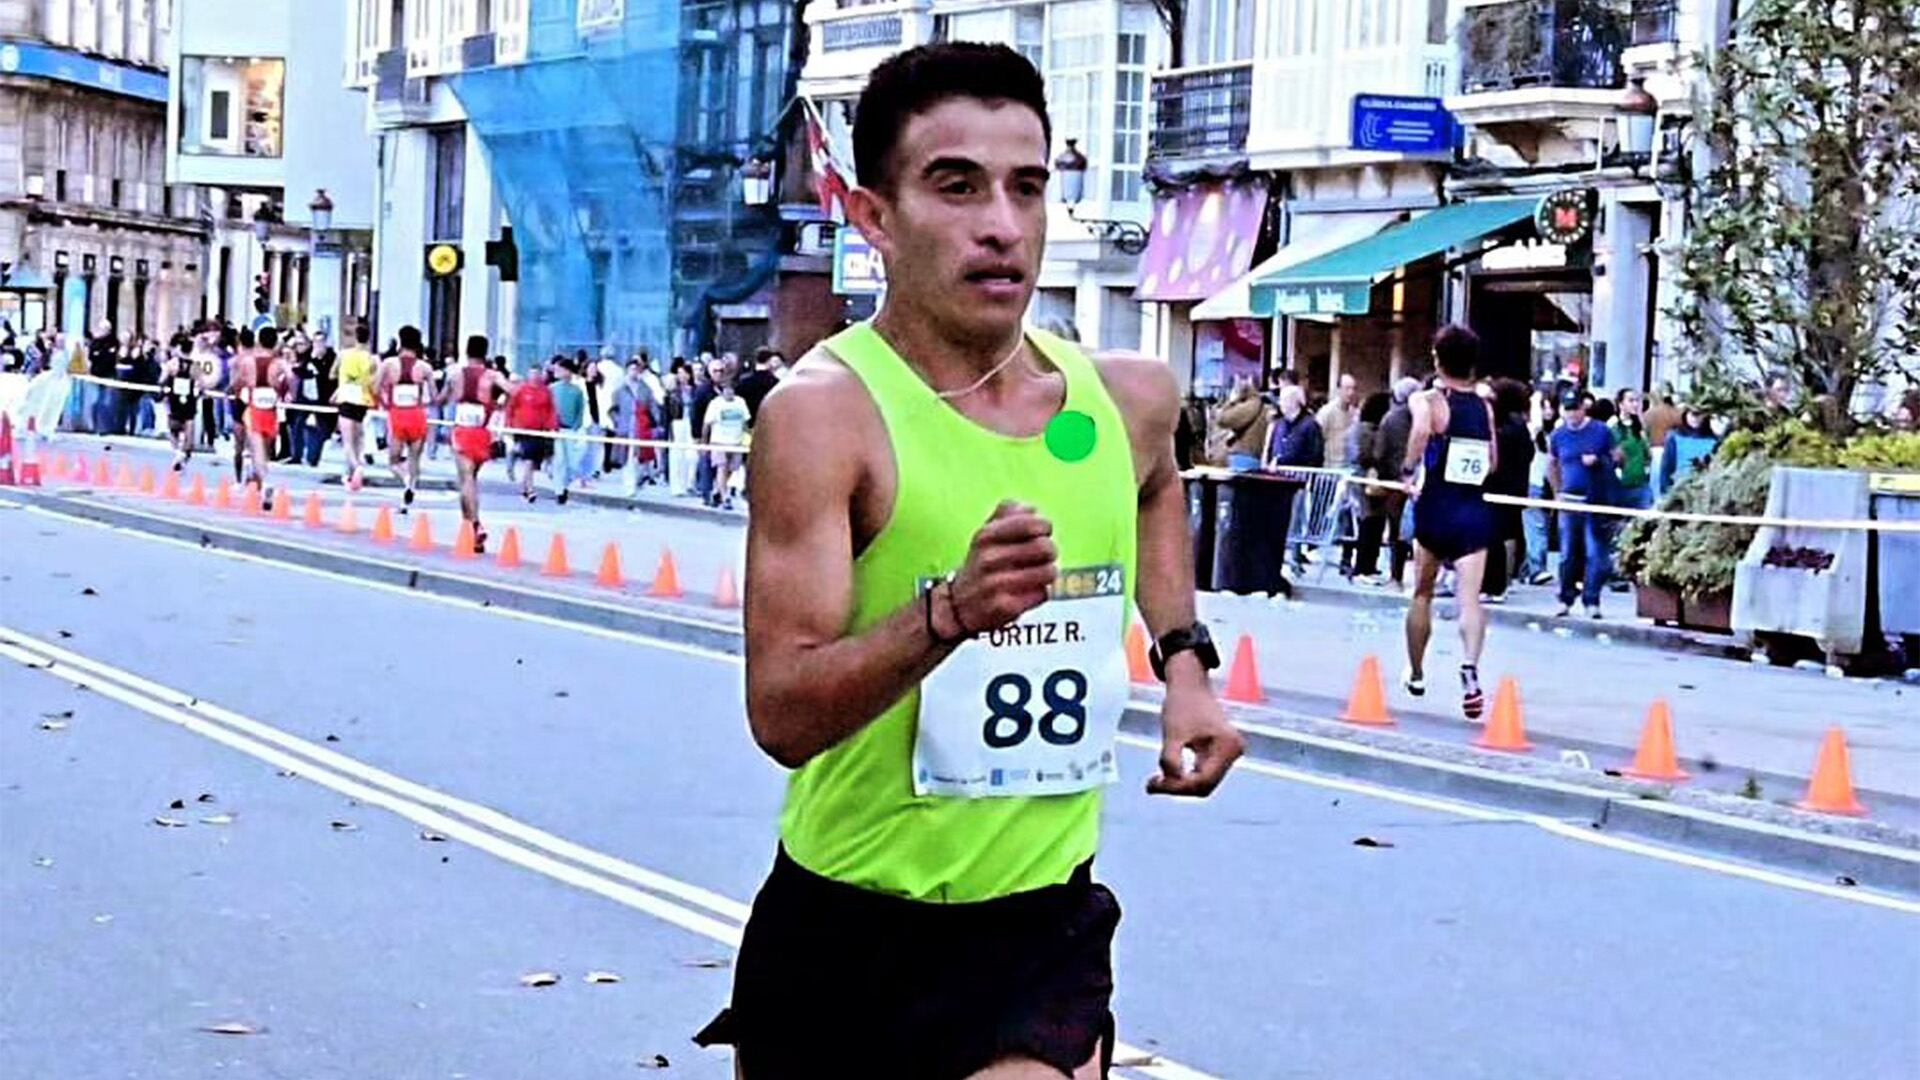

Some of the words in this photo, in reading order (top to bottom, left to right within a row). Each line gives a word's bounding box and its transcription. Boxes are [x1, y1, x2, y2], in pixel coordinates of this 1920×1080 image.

[1460, 458, 1482, 474] 76
[989, 623, 1058, 647] ORTIZ
[1065, 621, 1086, 642] R.
[983, 668, 1087, 748] 88
